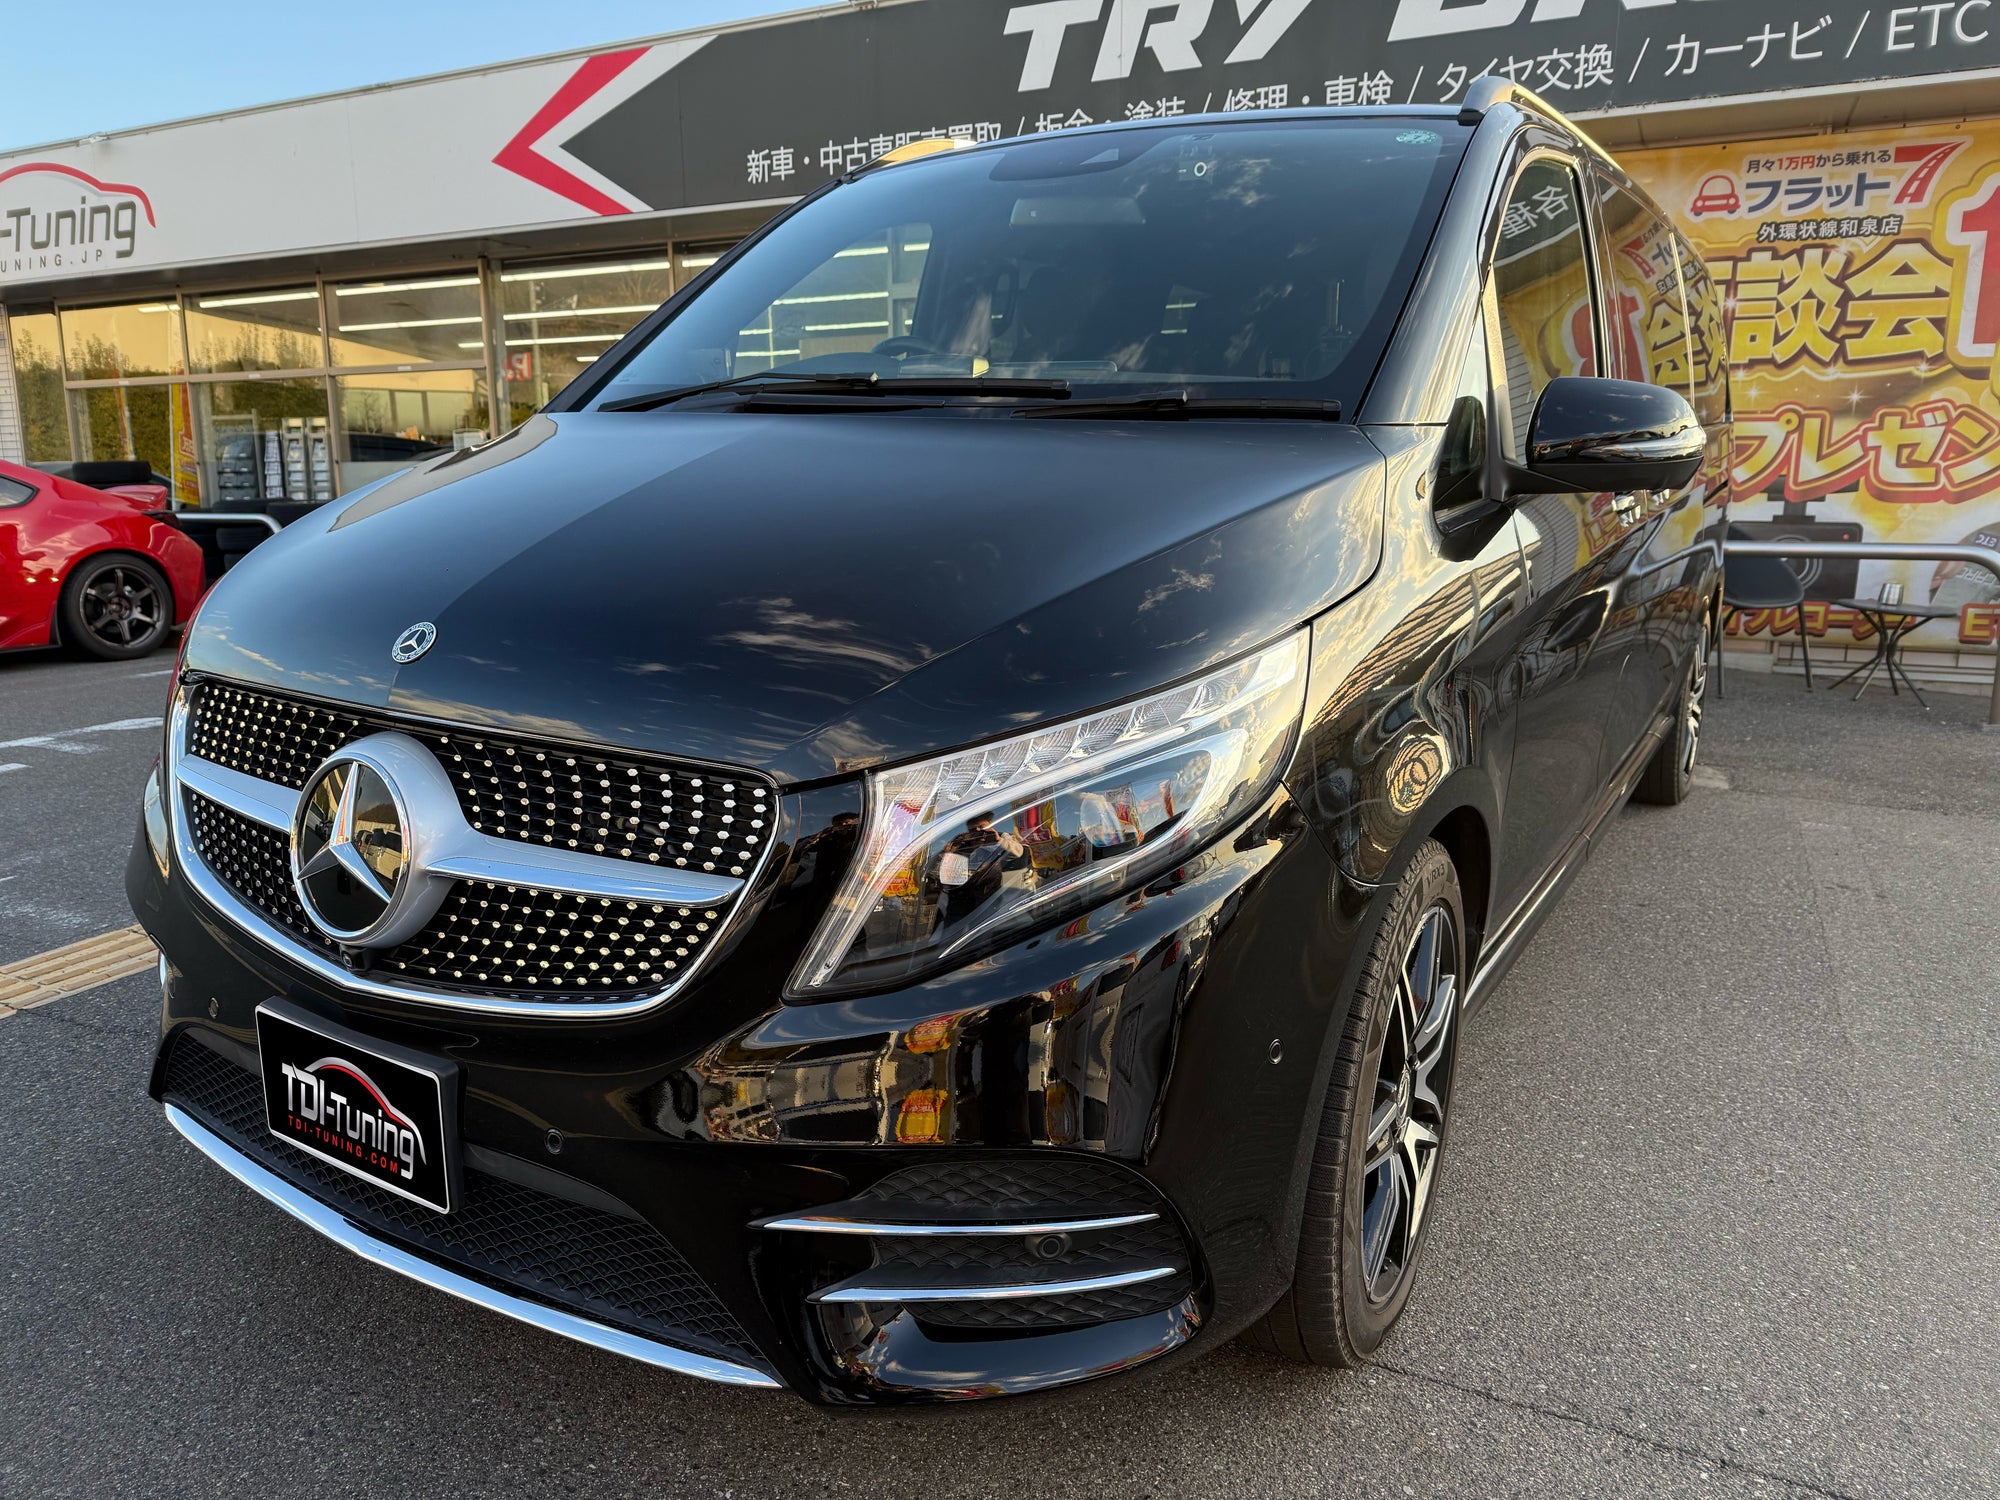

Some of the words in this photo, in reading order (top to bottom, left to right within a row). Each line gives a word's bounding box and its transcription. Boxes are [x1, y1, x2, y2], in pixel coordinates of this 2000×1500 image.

[1665, 15, 1833, 77] カーナビ
[1886, 0, 1990, 51] ETC
[1746, 149, 1892, 174] 月々1万円から乗れる
[1757, 216, 1902, 242] 外環状線和泉店
[1963, 607, 2000, 637] E
[288, 1114, 399, 1175] TDI-TUNING.COM
